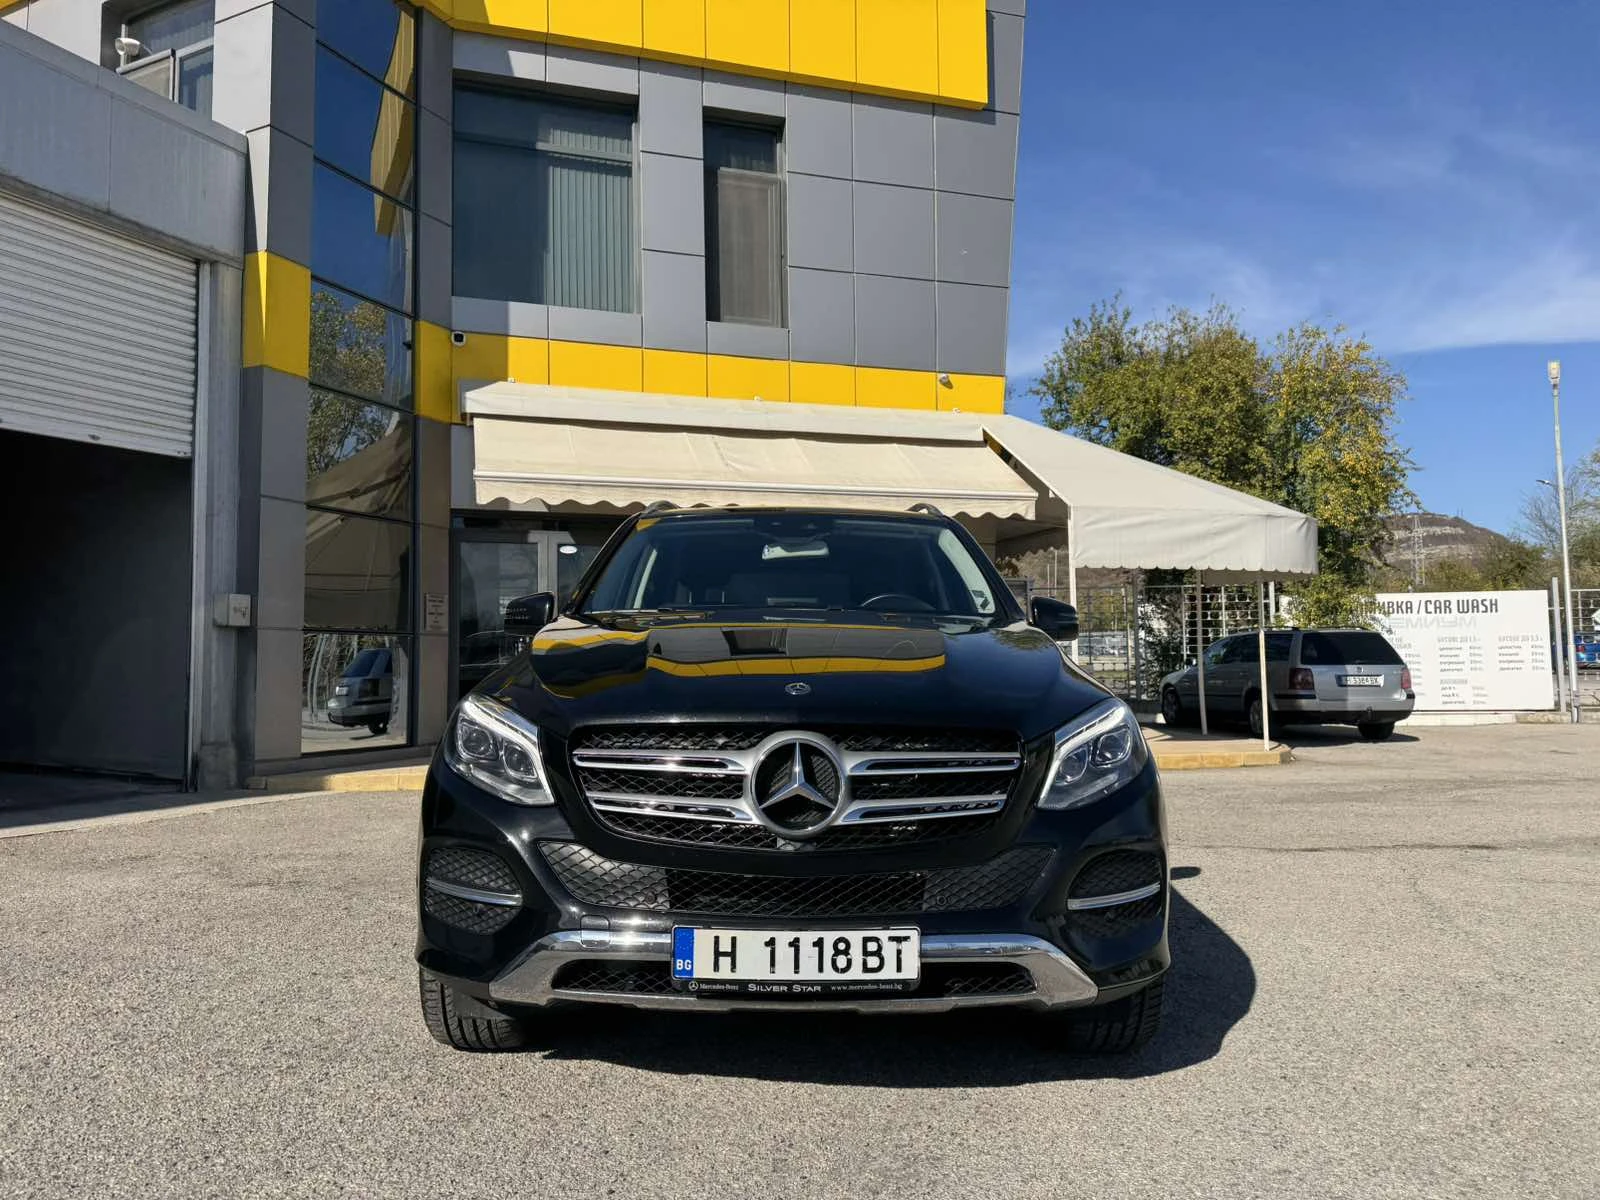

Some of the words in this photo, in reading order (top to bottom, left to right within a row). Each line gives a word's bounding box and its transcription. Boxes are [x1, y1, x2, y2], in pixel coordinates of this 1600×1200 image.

[1425, 599, 1452, 615] CAR
[1457, 598, 1499, 614] WASH
[712, 935, 737, 973] H
[676, 959, 692, 971] BG
[748, 983, 788, 993] SILVER
[792, 983, 822, 993] STAR
